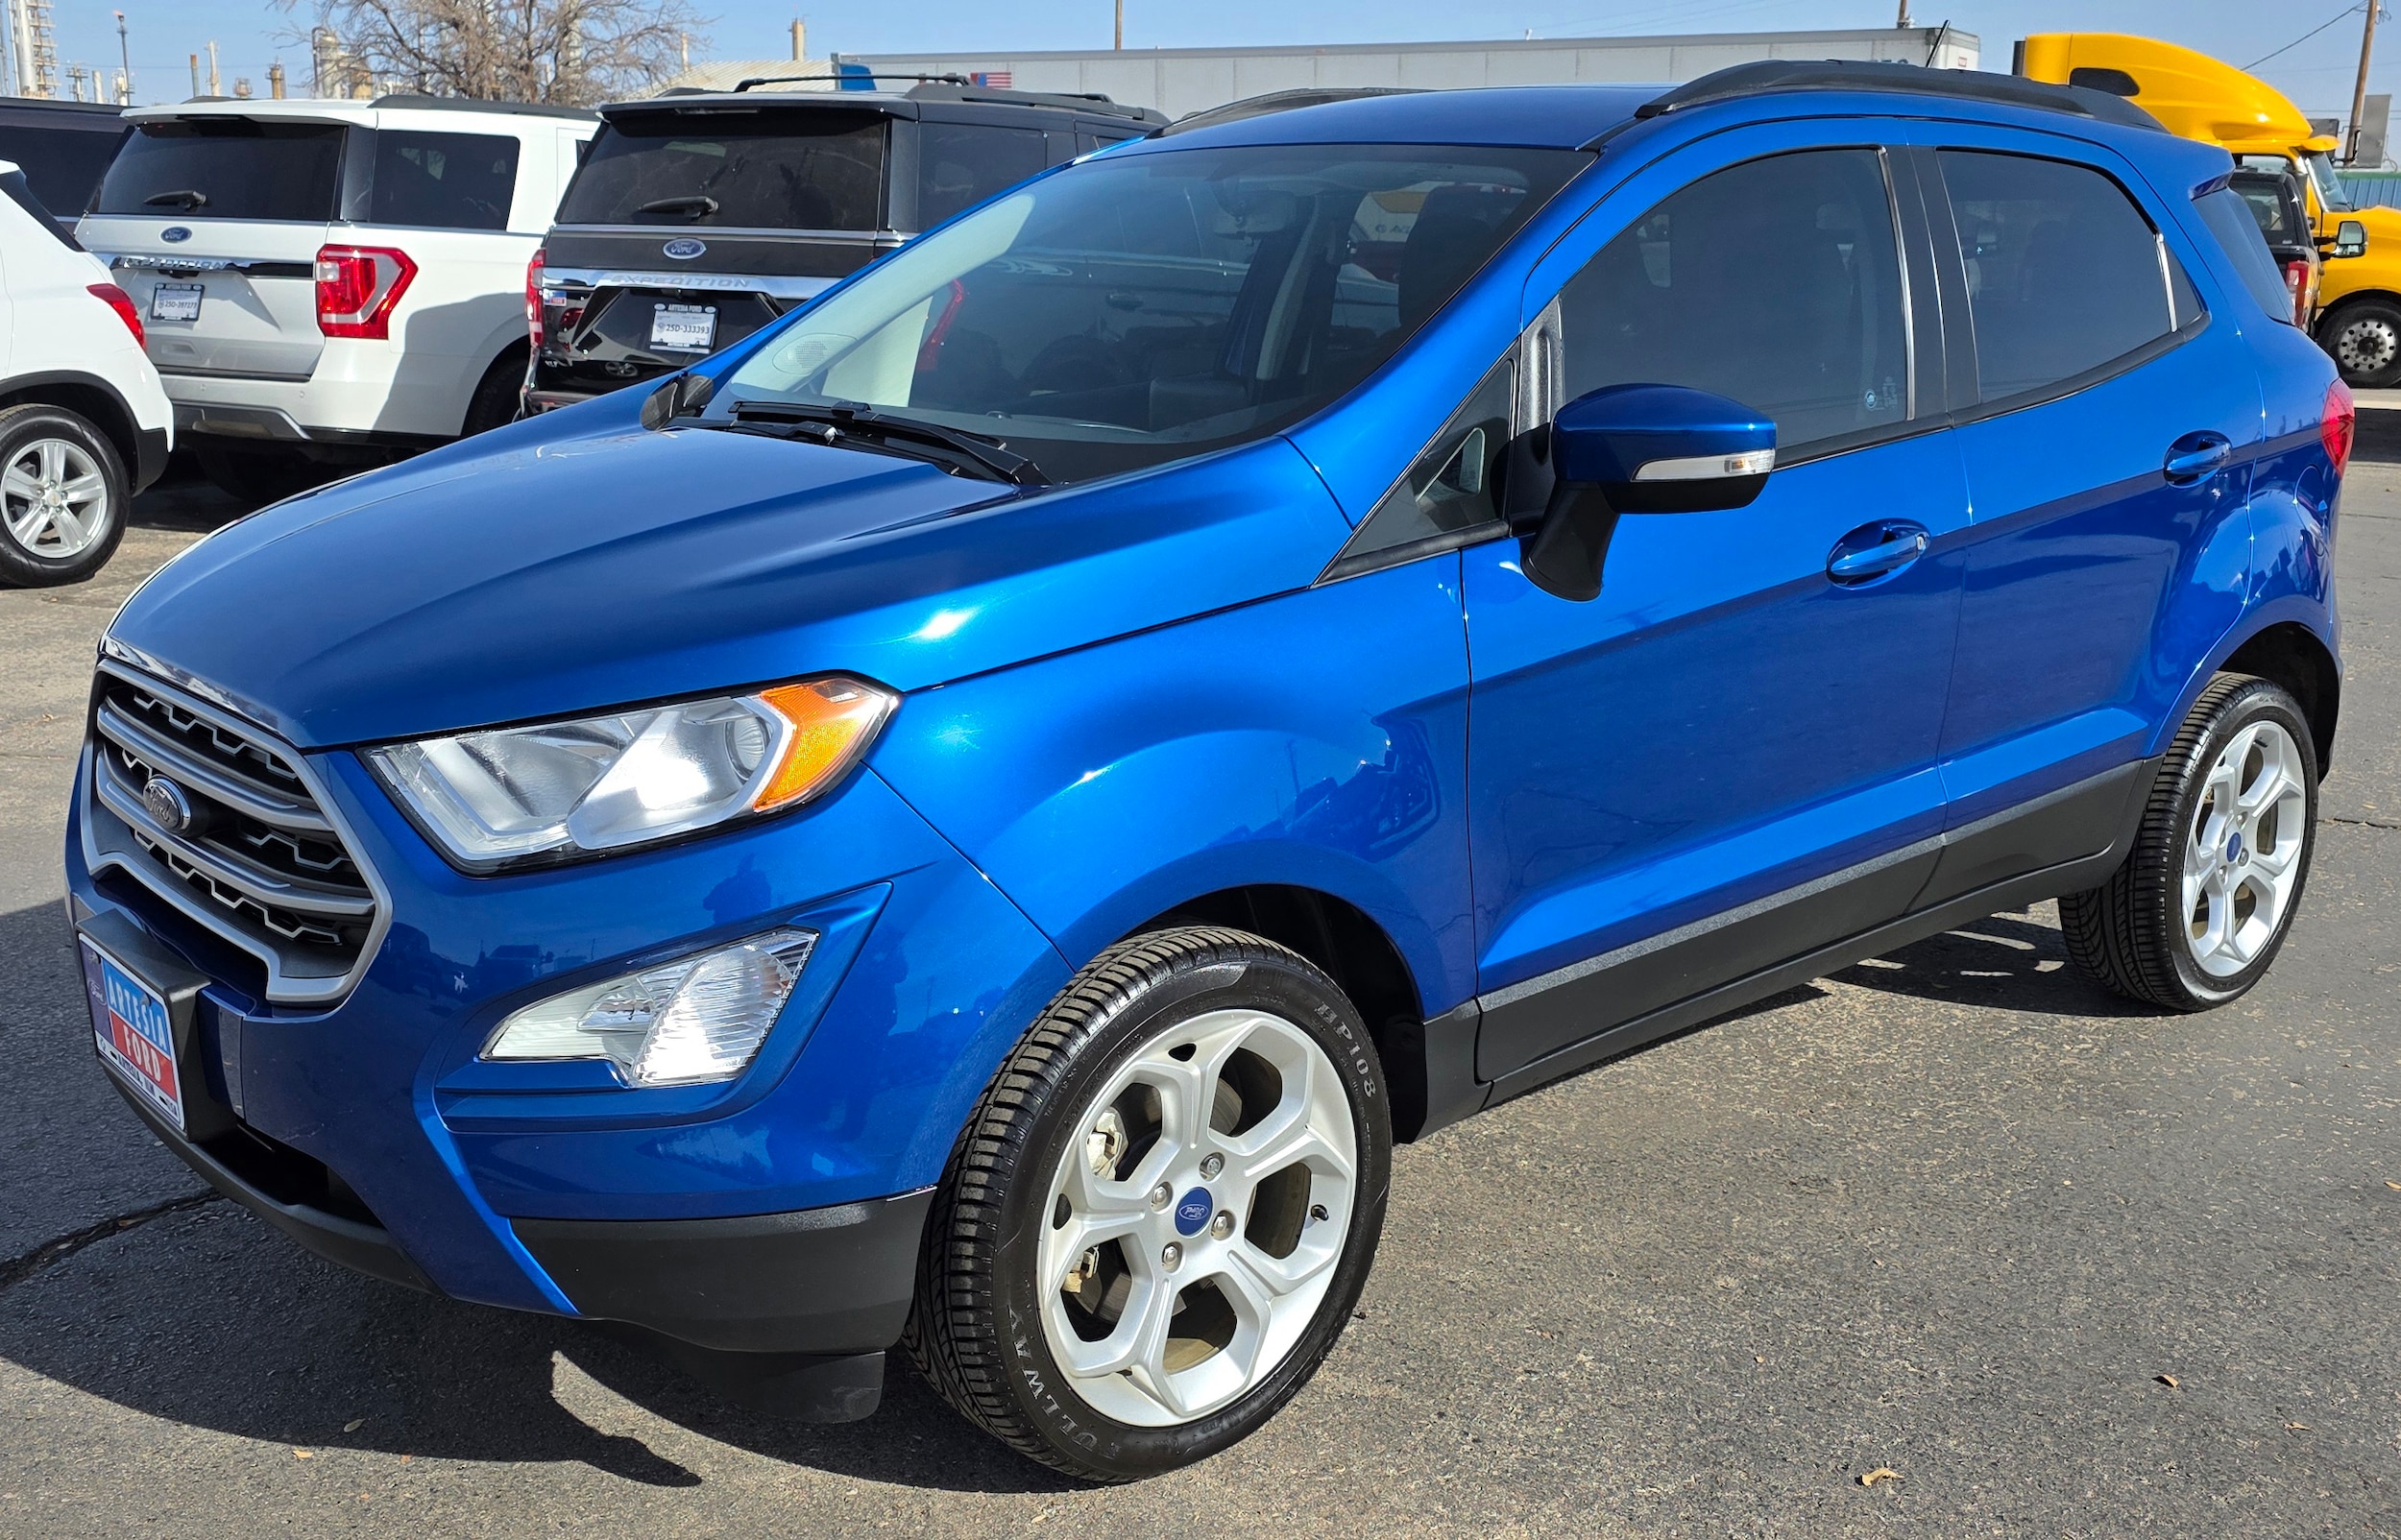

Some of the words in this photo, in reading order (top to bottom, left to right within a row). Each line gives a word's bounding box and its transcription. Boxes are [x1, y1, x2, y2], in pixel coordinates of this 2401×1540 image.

[670, 241, 694, 254] Ford
[611, 275, 751, 288] EXPEDITION
[108, 975, 167, 1050] ARTESIA
[123, 1023, 161, 1082] FORD
